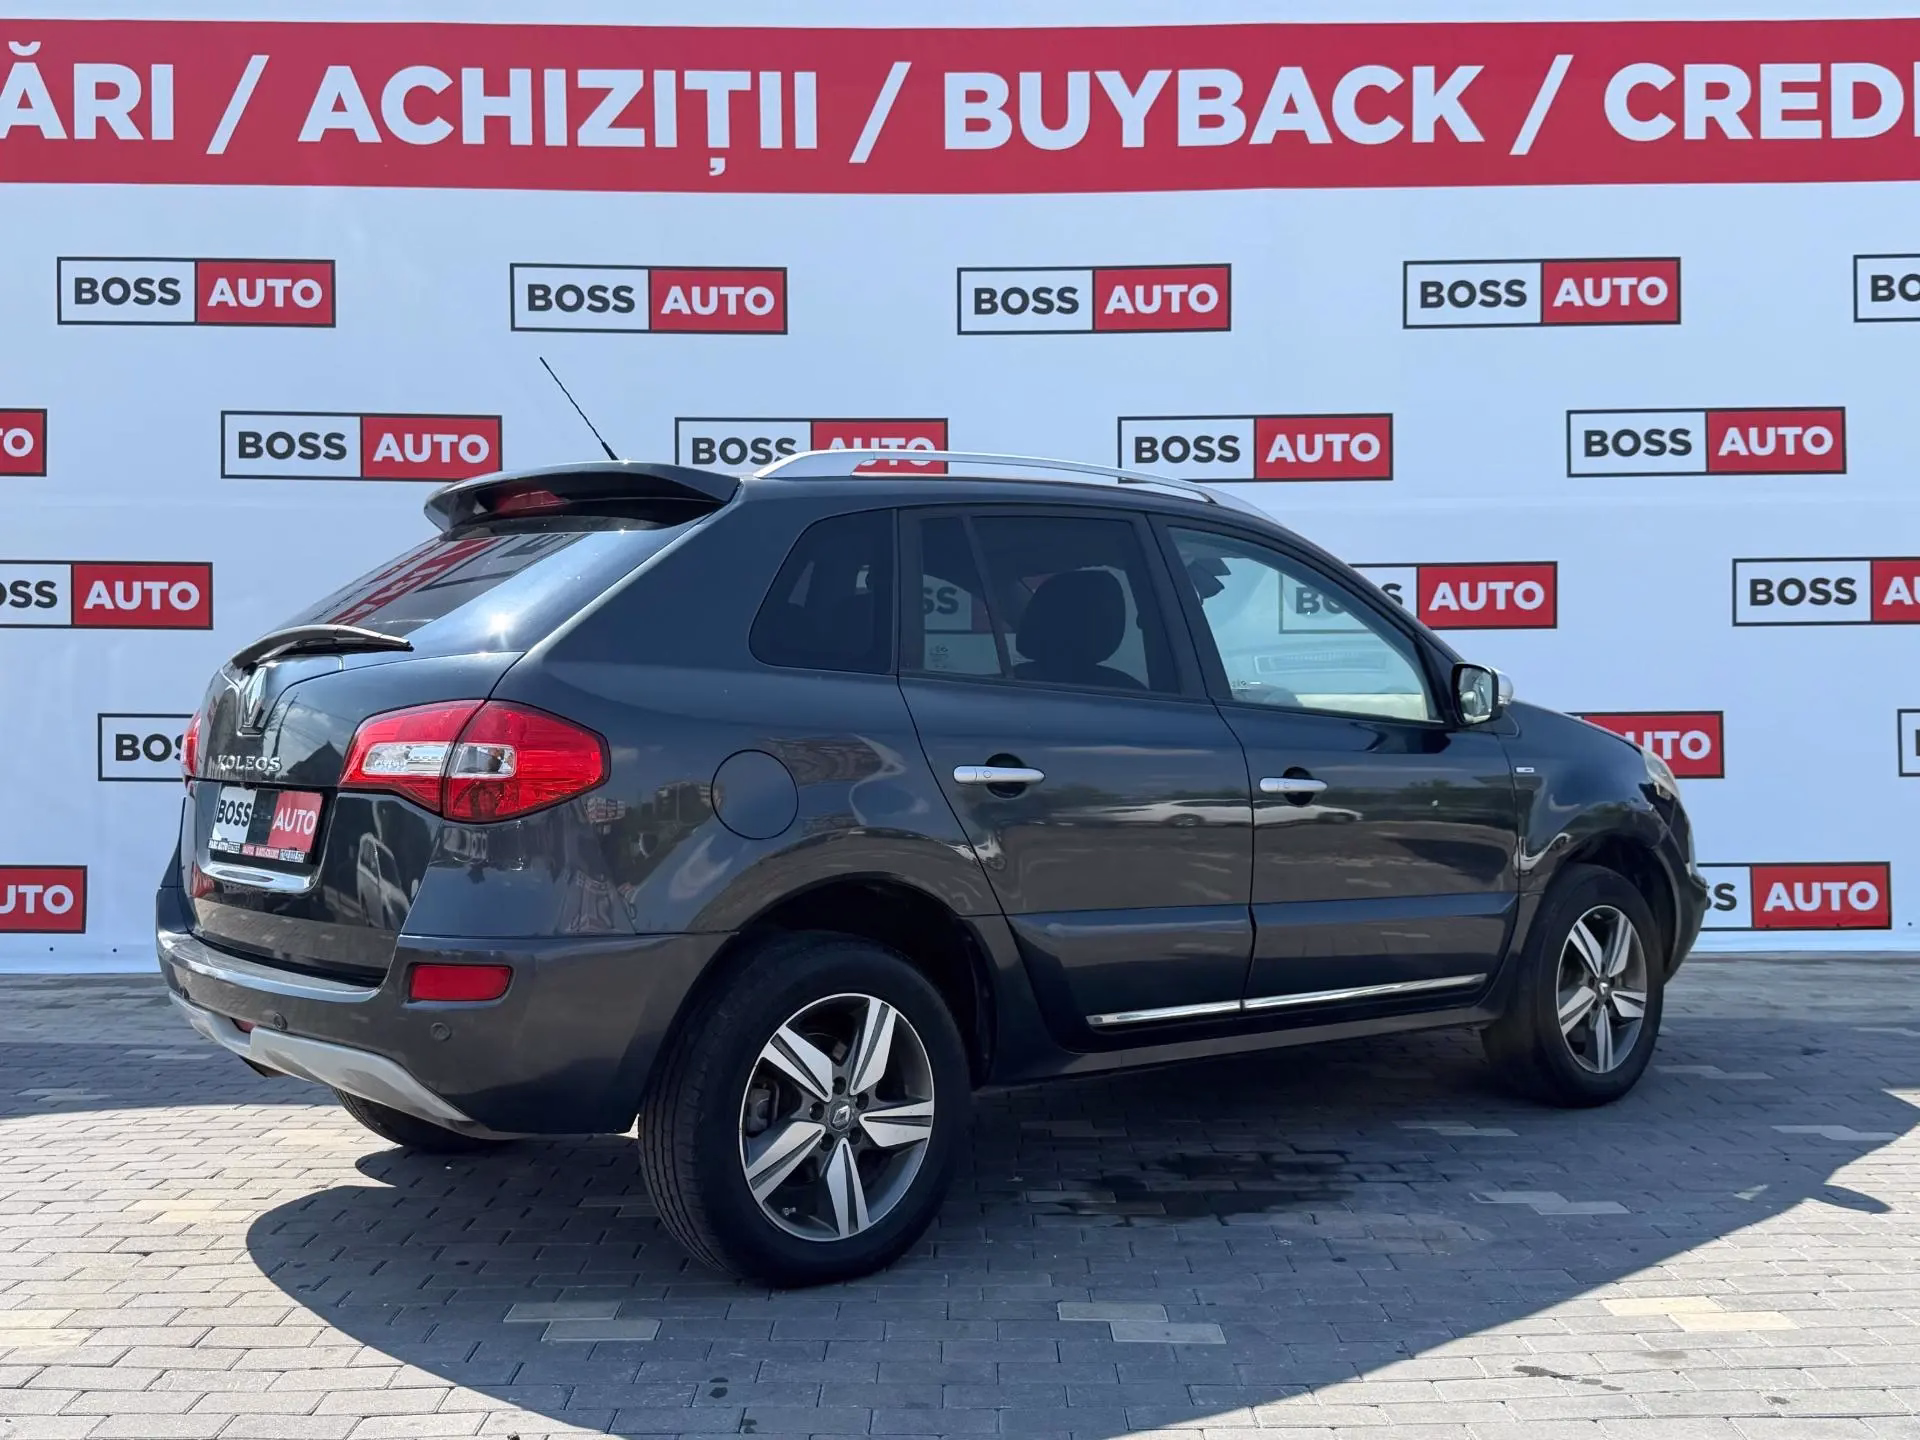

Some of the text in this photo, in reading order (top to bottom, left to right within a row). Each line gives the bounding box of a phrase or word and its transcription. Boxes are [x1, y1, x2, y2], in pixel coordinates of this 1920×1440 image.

[944, 65, 1485, 150] BUYBACK
[1604, 61, 1920, 141] CRED
[74, 277, 322, 308] BOSS AUTO
[527, 284, 774, 316] BOSS AUTO
[974, 283, 1219, 315] BOSS AUTO
[1420, 276, 1668, 309] BOSS AUTO
[0, 428, 34, 457] O
[238, 431, 489, 463] BOSS AUTO
[1135, 433, 1380, 464] BOSS AUTO
[1584, 426, 1833, 457] BOSS AUTO
[0, 580, 200, 610] SS AUTO
[1429, 580, 1544, 611] AUTO
[1750, 576, 1920, 606] BOSS A
[218, 755, 282, 771] KOLEOS
[216, 799, 318, 835] BOSS AUTO
[1763, 881, 1879, 911] AUTO
